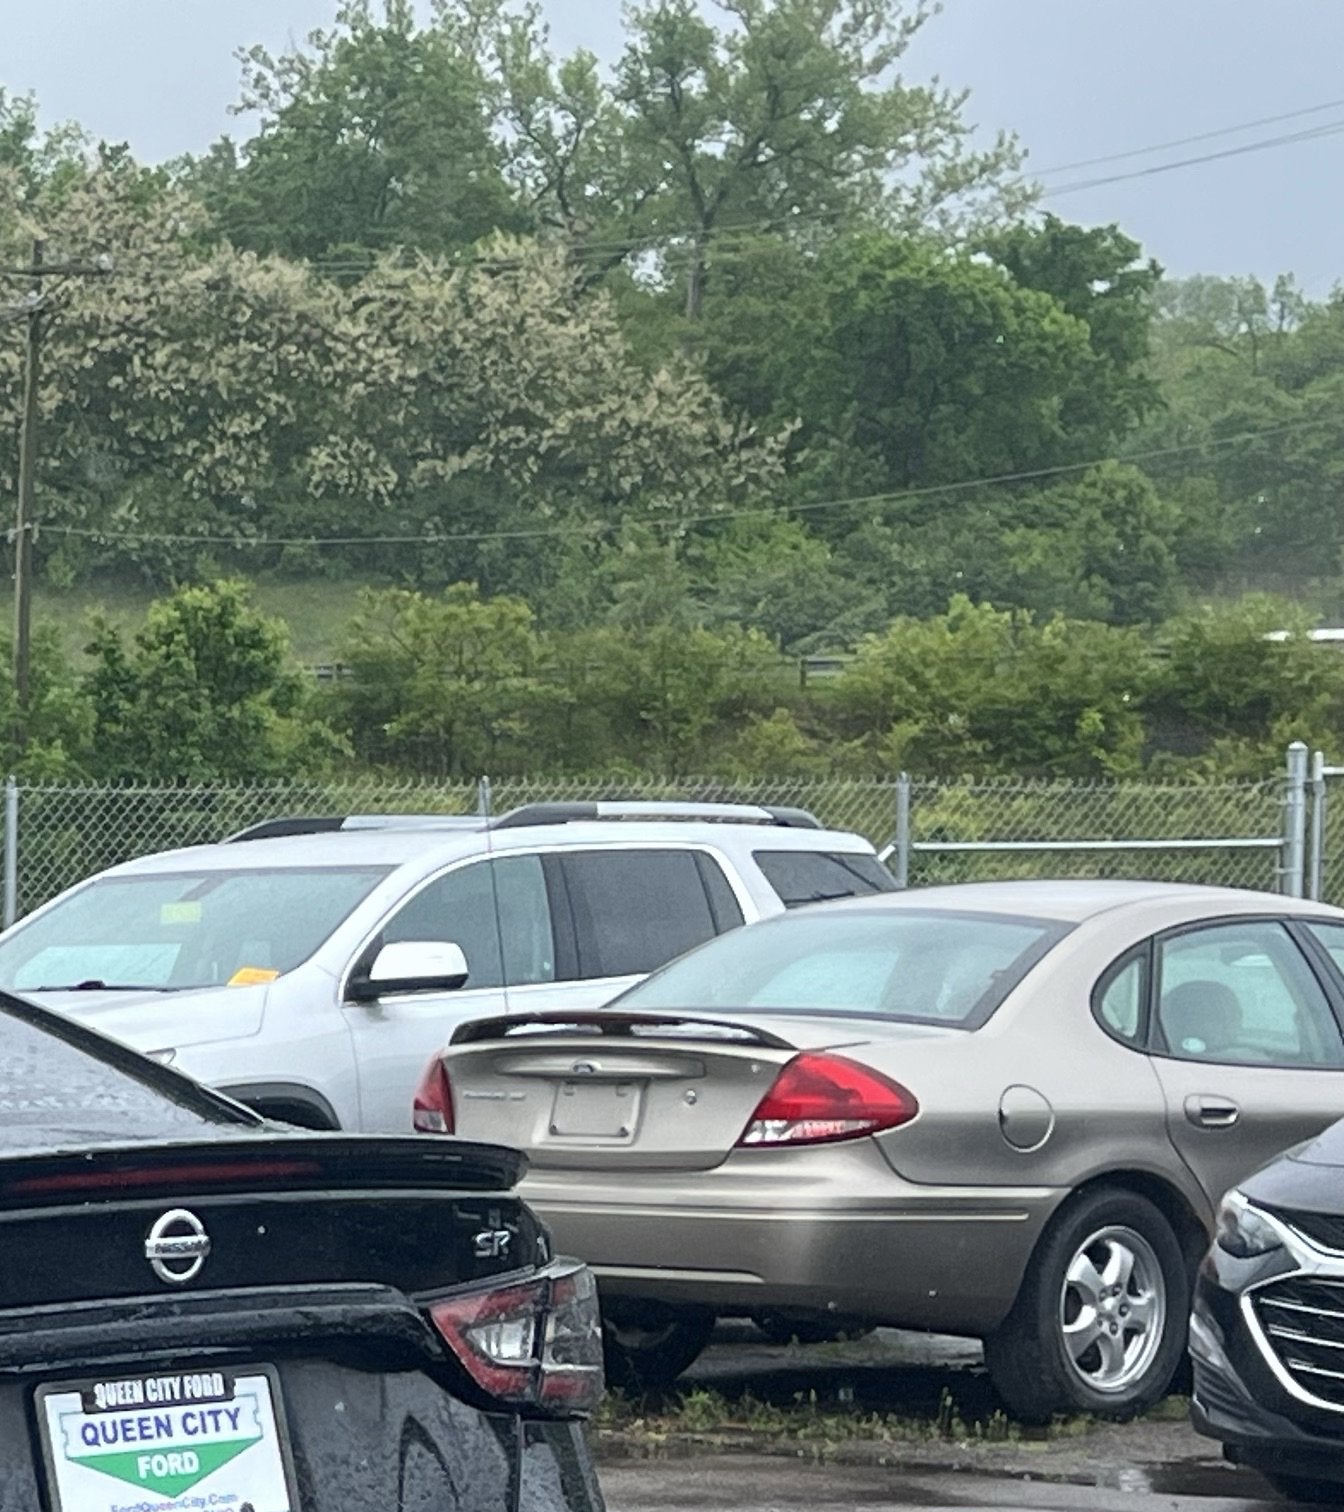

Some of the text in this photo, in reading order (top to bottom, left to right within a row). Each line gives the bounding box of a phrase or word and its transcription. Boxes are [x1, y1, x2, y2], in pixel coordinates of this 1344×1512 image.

[93, 1372, 225, 1409] QUEEN CITY FORD
[81, 1407, 241, 1447] QUEEN CITY
[137, 1451, 200, 1479] FORD
